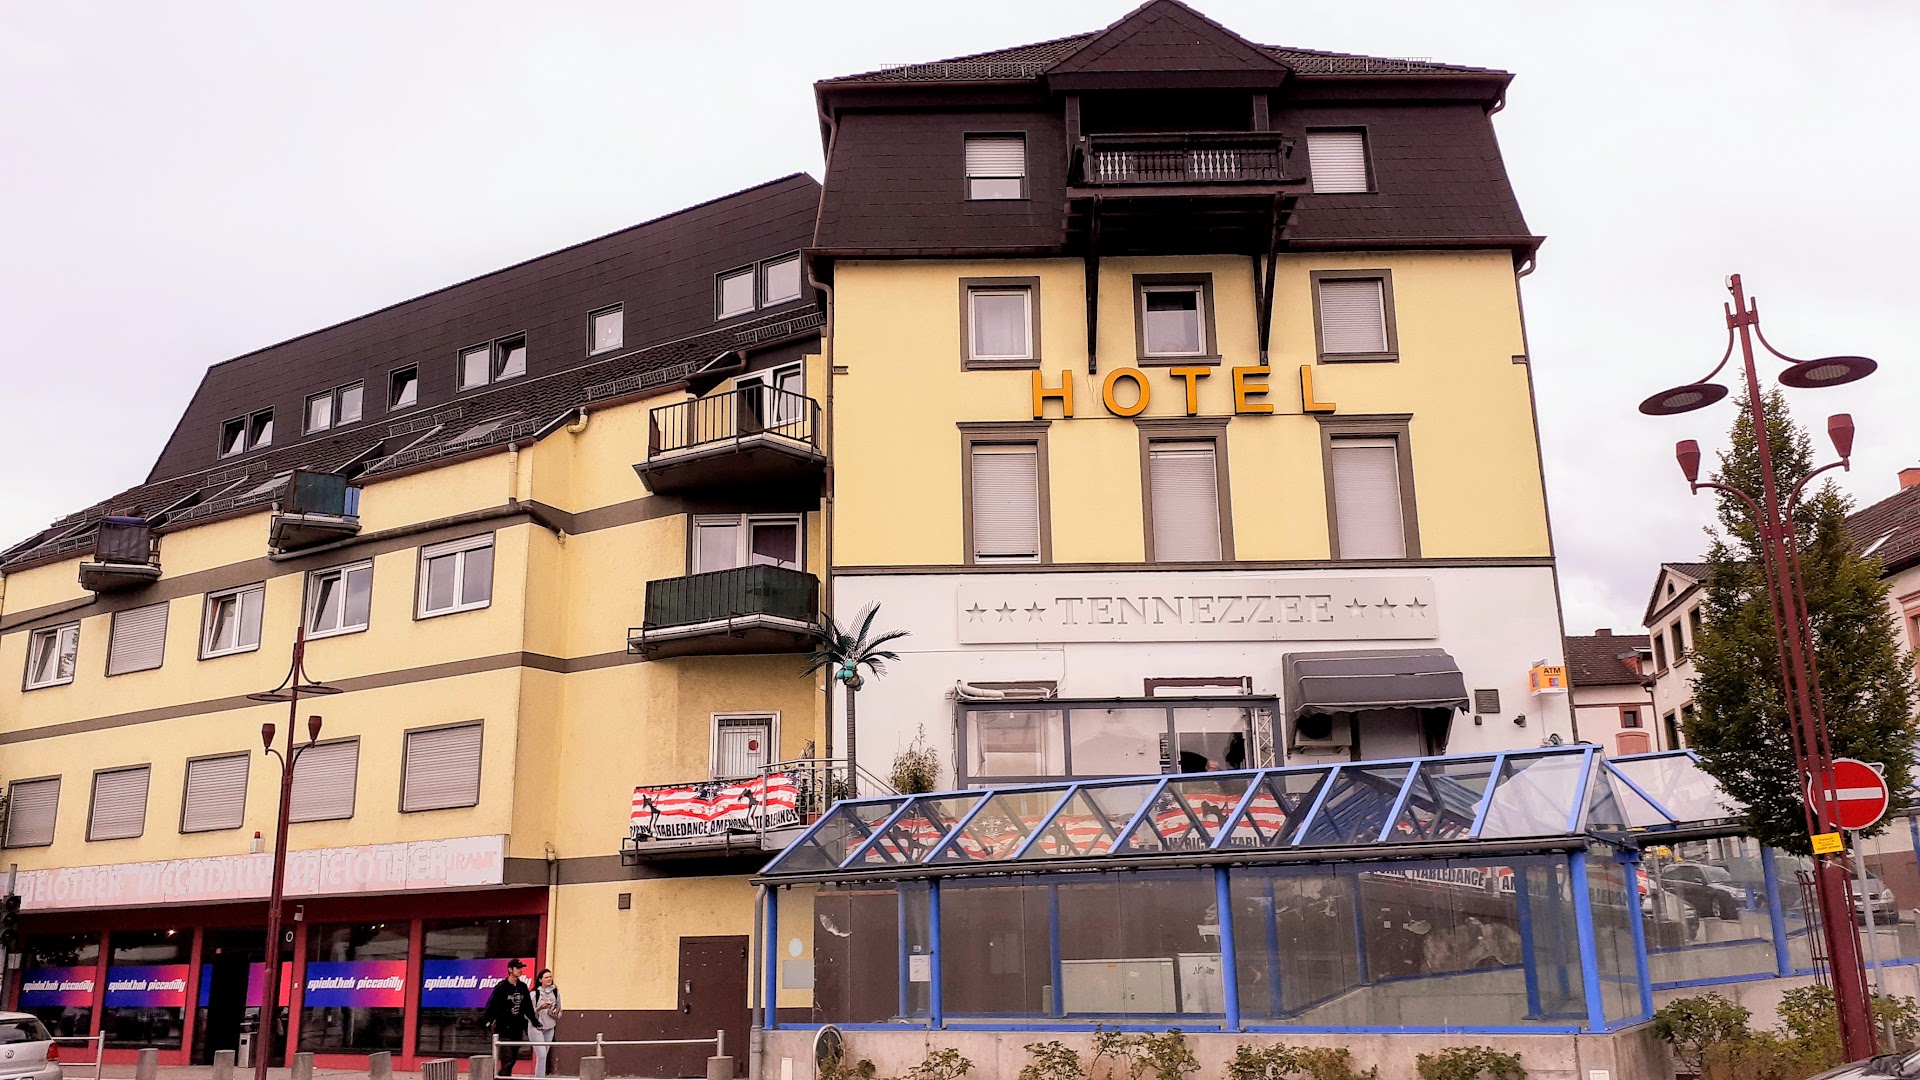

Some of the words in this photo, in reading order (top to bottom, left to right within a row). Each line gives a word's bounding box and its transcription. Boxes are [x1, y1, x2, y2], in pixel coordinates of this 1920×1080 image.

[1031, 365, 1336, 420] HOTEL
[1055, 594, 1334, 626] TENNEZZEE
[656, 820, 709, 837] TABLEDANCE
[59, 979, 95, 992] piccadilly
[148, 979, 186, 992] piccadilly
[307, 977, 356, 991] spielothek
[356, 976, 404, 991] piccadilly
[424, 975, 478, 991] spielothek
